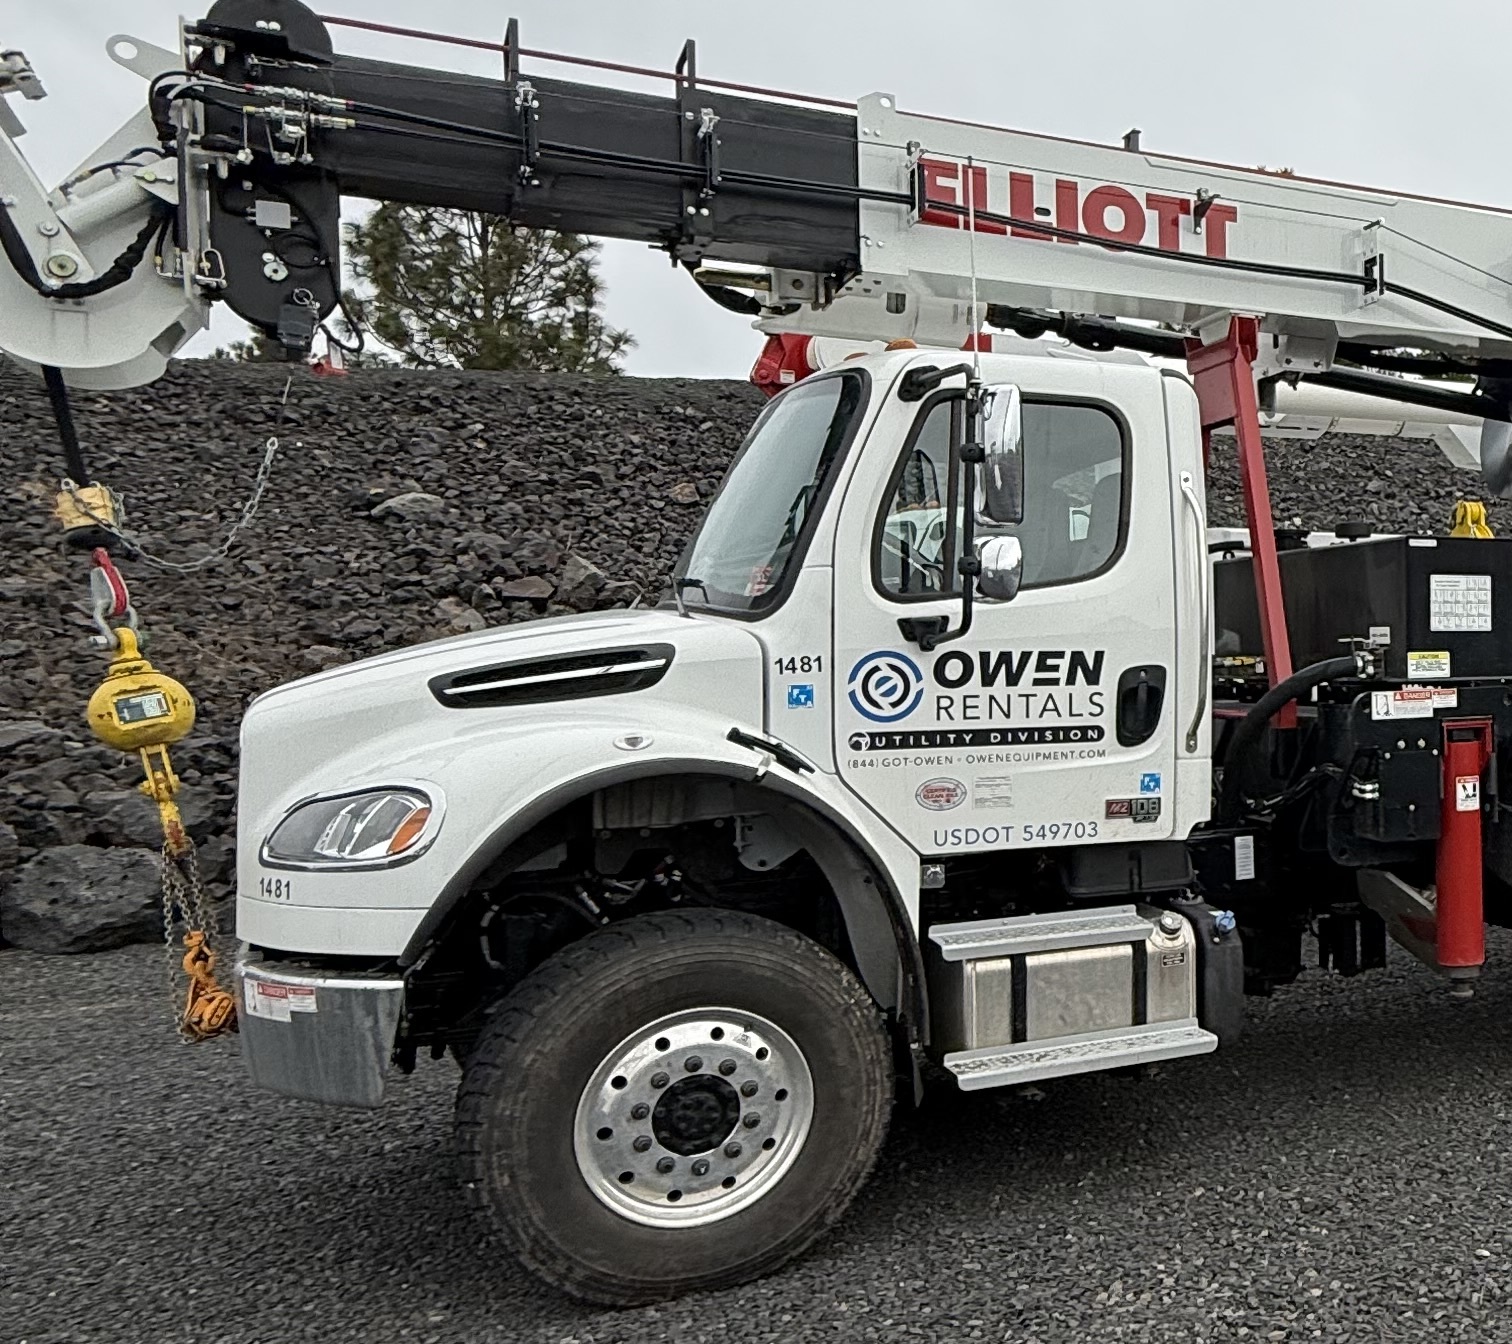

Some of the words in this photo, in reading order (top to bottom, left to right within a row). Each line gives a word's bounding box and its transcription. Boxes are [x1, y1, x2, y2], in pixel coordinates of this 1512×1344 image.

[917, 158, 1238, 259] ELLIOTT
[774, 655, 822, 675] 1481
[933, 650, 1105, 689] OWEN
[936, 691, 1105, 721] RENTALS
[875, 733, 974, 748] UTILITY
[990, 728, 1098, 744] DIVISION
[847, 758, 879, 769] (844)
[881, 756, 954, 768] GOT-OWEN
[965, 749, 1107, 765] OWENEQUIPMENT.COM
[933, 826, 1015, 847] USDOT
[1022, 821, 1098, 842] 549703
[259, 877, 291, 900] 1481
